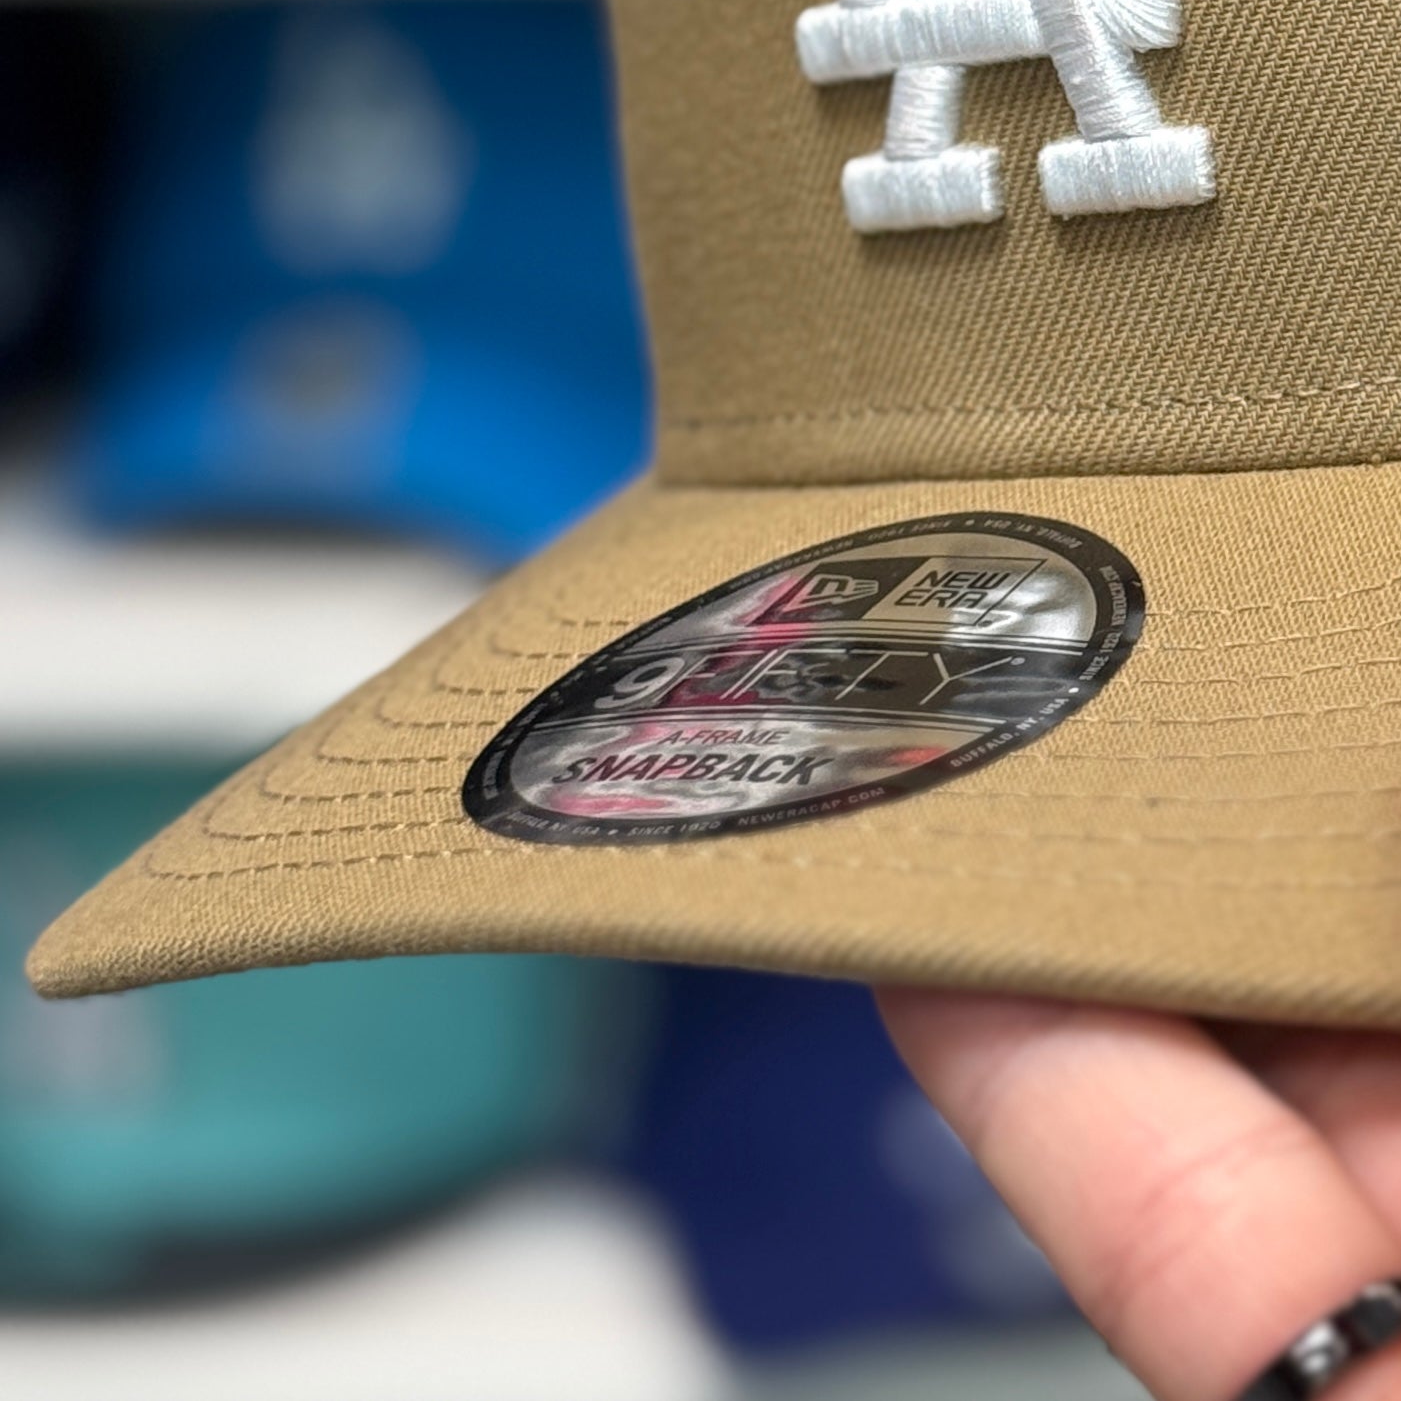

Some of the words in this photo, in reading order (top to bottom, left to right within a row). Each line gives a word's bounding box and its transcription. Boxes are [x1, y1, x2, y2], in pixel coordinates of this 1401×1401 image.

[915, 569, 1011, 591] NEW
[893, 589, 991, 609] ERA
[1041, 697, 1070, 716] USA
[655, 729, 791, 746] A-FRAME
[552, 753, 836, 786] SNAPBACK
[627, 824, 675, 837] SINCE
